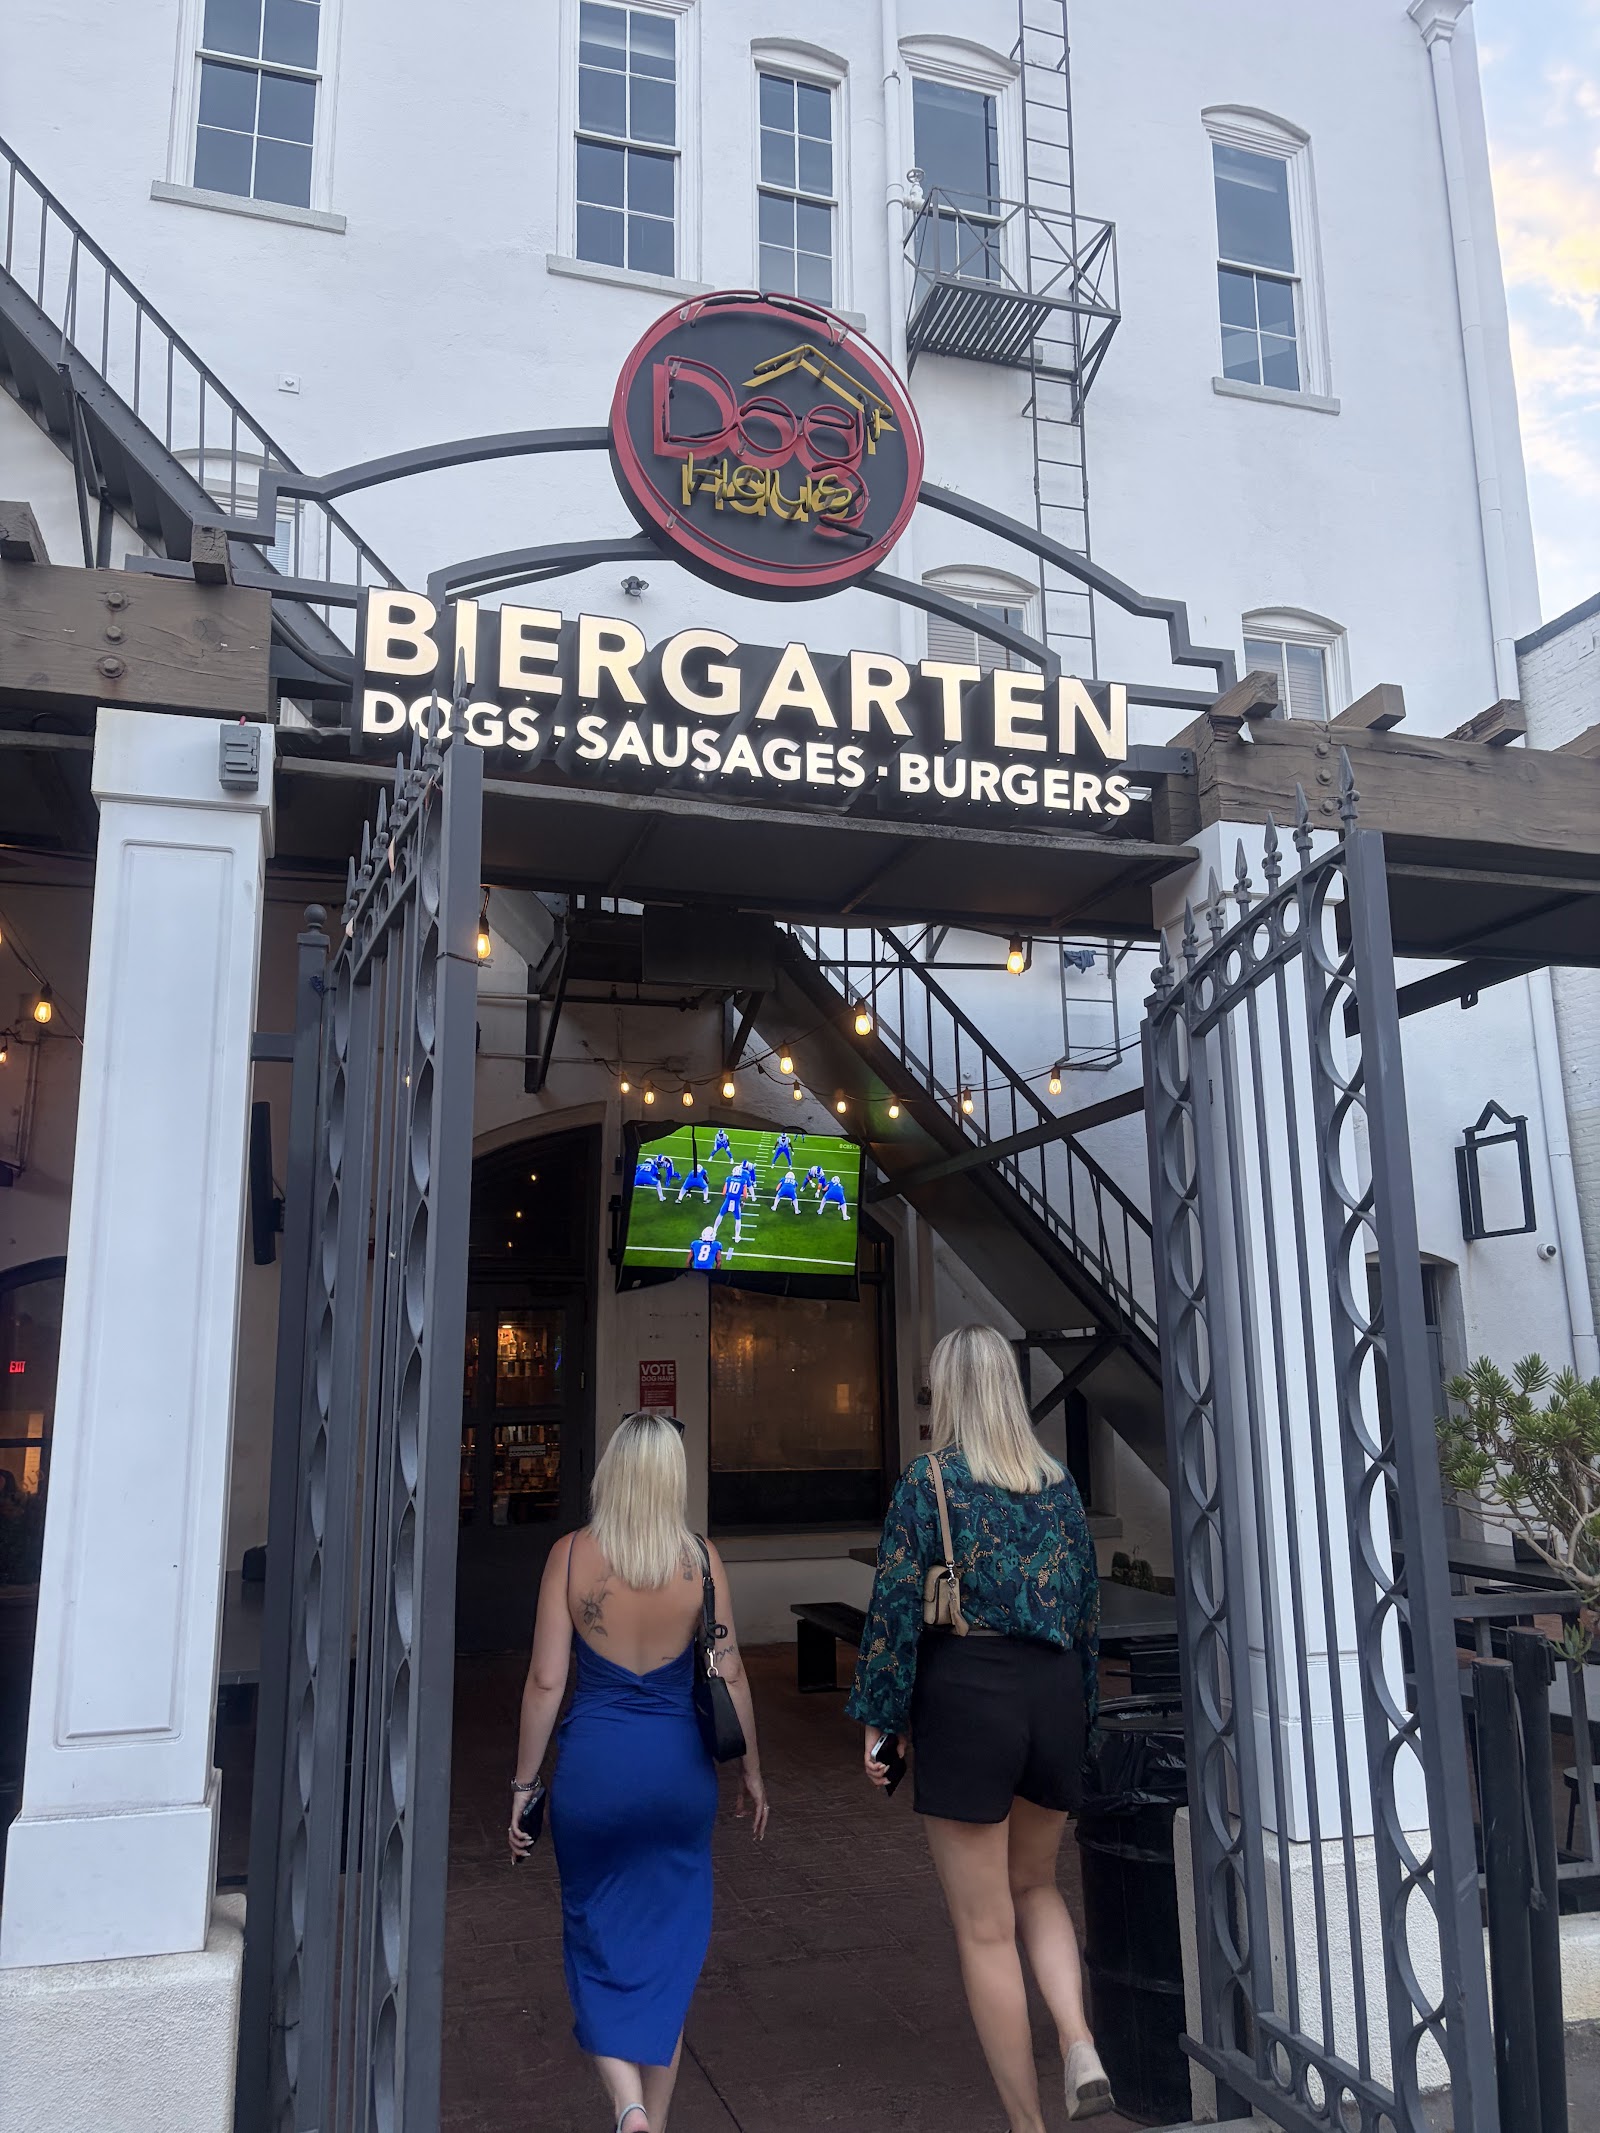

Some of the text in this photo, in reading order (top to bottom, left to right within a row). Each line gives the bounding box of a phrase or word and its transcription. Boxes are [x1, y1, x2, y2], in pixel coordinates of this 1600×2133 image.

[365, 587, 1128, 762] BIERGARTEN
[363, 690, 1131, 817] DOGS SAUSAGES BURGERS
[728, 1181, 741, 1195] 10
[698, 1244, 711, 1261] 8
[641, 1363, 675, 1375] VOTE
